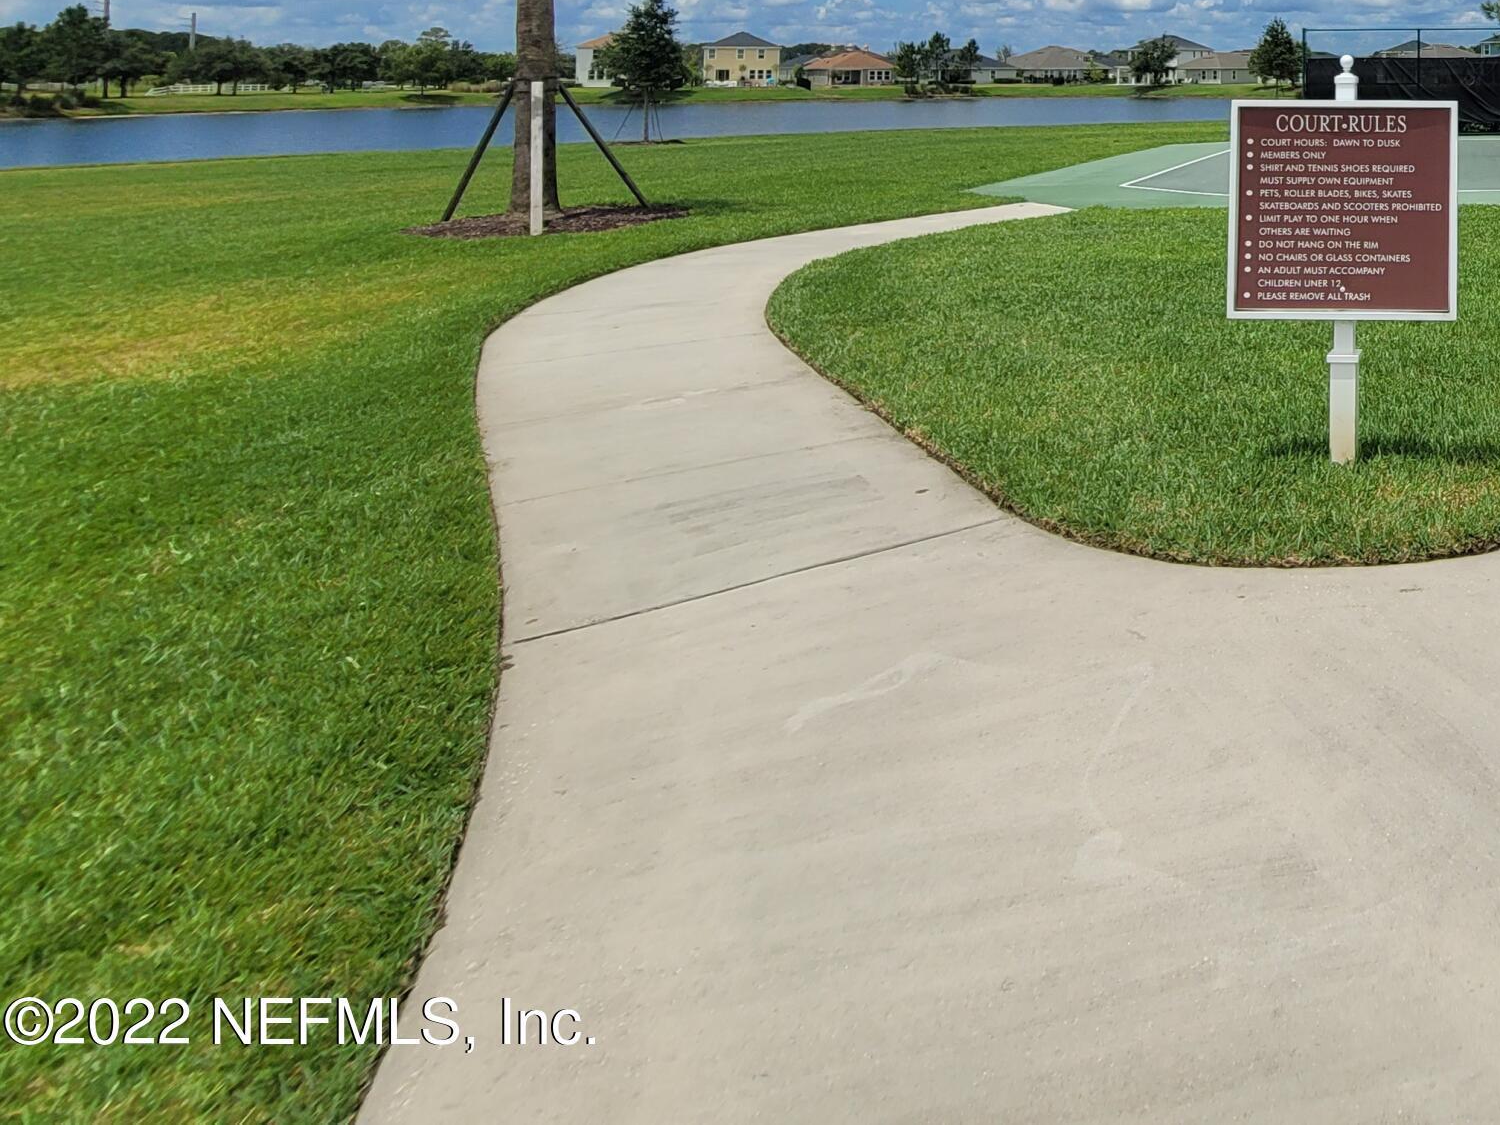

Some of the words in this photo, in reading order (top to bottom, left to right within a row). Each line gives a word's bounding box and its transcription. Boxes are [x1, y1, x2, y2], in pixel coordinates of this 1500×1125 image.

[1260, 138, 1292, 147] COURT
[1293, 138, 1328, 147] HOURS:
[1332, 138, 1360, 147] DAWN
[1362, 138, 1375, 148] TO
[1377, 139, 1401, 148] DUSK
[1260, 150, 1301, 160] MEMBERS
[1302, 150, 1327, 160] ONLY
[1260, 163, 1284, 172] SHIRT
[1284, 163, 1306, 172] AND
[1307, 163, 1339, 173] TENNIS
[1340, 164, 1370, 173] SHOES
[1371, 164, 1416, 173] REQUIRED
[1259, 176, 1285, 185] MUST
[1285, 176, 1316, 185] SUPPLY
[1317, 176, 1341, 185] OWN
[1343, 176, 1394, 186] EQUIPMENT
[1259, 188, 1282, 198] PETS,
[1284, 189, 1316, 198] ROLLER
[1317, 189, 1352, 199] BLADES,
[1354, 189, 1380, 199] BIKES,
[1381, 189, 1413, 199] SKATES
[1259, 201, 1320, 211] SKATEBOARDS
[1321, 202, 1342, 211] AND
[1343, 202, 1390, 211] SCOOTERS
[1391, 202, 1443, 212] PROHIBITED
[1259, 214, 1282, 223] LIMIT
[1283, 214, 1304, 223] PLAY
[1305, 214, 1318, 223] TO
[1320, 214, 1340, 224] ONE
[1342, 214, 1369, 224] HOUR
[1370, 215, 1398, 224] WHEN
[1258, 227, 1293, 236] OTHERS
[1294, 227, 1311, 236] ARE
[1312, 227, 1351, 237] WAITING
[1258, 240, 1274, 249] DO
[1275, 240, 1296, 249] NOT
[1297, 240, 1325, 249] HANG
[1326, 240, 1342, 249] ON
[1344, 240, 1361, 250] THE
[1363, 241, 1379, 249] RIM
[1258, 253, 1274, 262] NO
[1275, 253, 1308, 262] CHAIRS
[1309, 253, 1324, 262] OR
[1325, 253, 1353, 262] GLASS
[1355, 253, 1411, 263] CONTAINERS
[1257, 266, 1272, 274] AN
[1273, 266, 1302, 275] ADULT
[1303, 266, 1329, 275] MUST
[1328, 266, 1386, 275] ACCOMPANY
[1257, 278, 1302, 288] CHILDREN
[1257, 291, 1287, 301] PLEASE
[1289, 292, 1325, 301] REMOVE
[1327, 292, 1343, 301] ALL
[1343, 292, 1371, 301] TRASH
